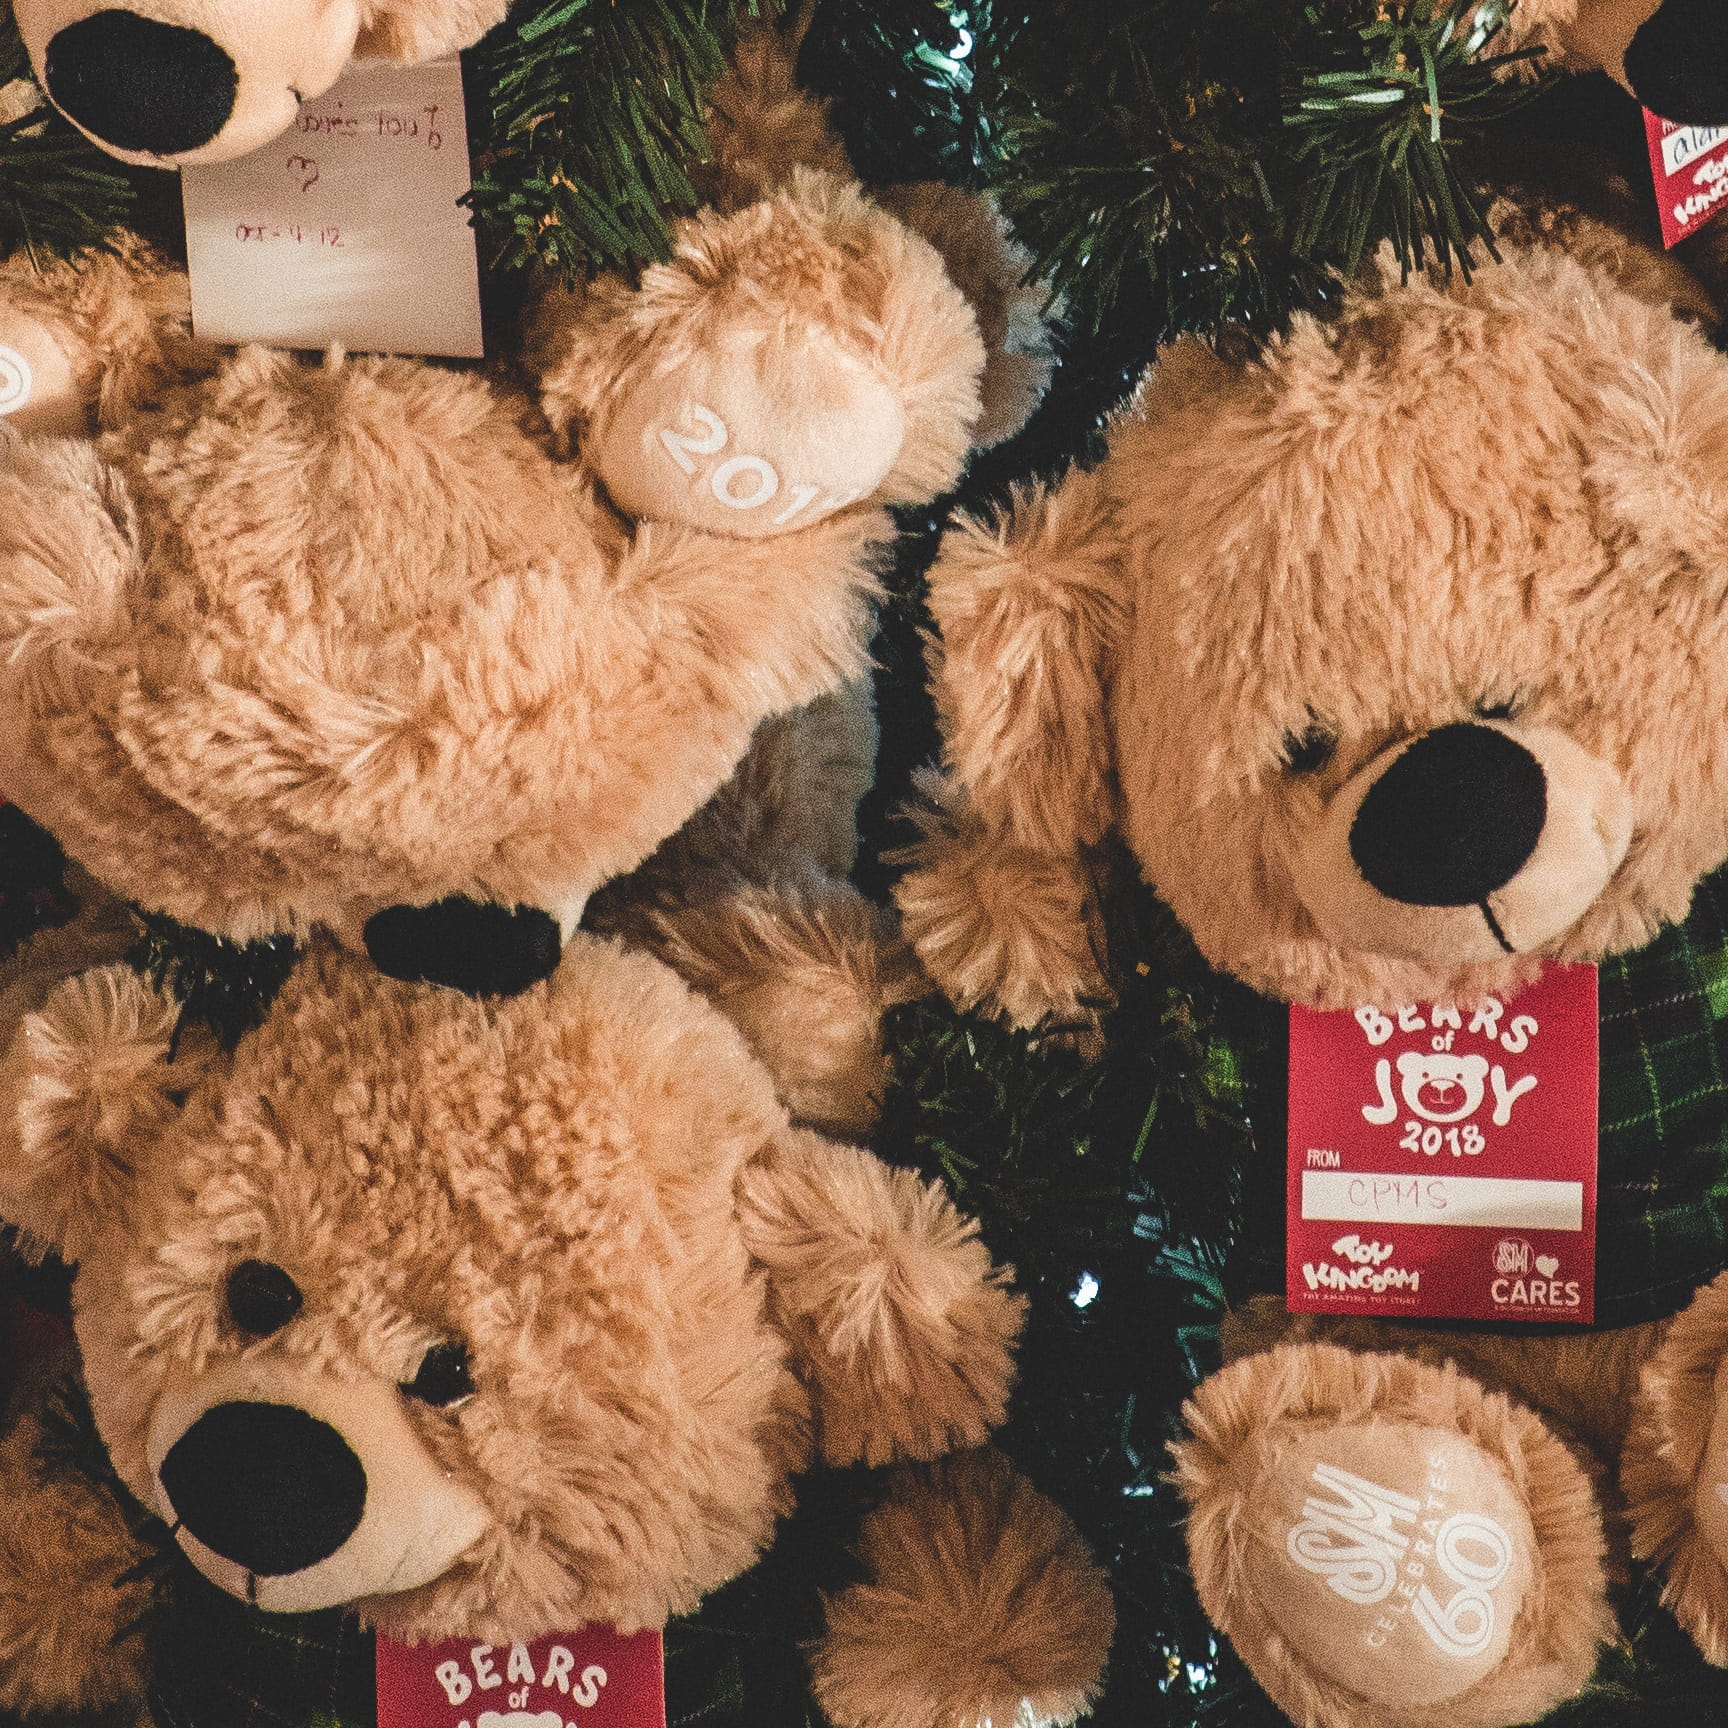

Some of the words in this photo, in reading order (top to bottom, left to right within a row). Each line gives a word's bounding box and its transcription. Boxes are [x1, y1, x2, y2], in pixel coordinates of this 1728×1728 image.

[1430, 1030, 1455, 1052] of
[1360, 1051, 1539, 1128] JOY
[1398, 1120, 1487, 1158] 2018
[1305, 1147, 1342, 1168] FROM
[1331, 1233, 1394, 1266] TOY
[1302, 1260, 1421, 1294] KINGDOM
[1490, 1277, 1582, 1308] CARES
[1286, 1462, 1421, 1604] SM
[1363, 1451, 1448, 1648] CELEBRATES
[1411, 1512, 1514, 1658] 60
[434, 1641, 609, 1709] BEARS
[507, 1684, 530, 1710] of
